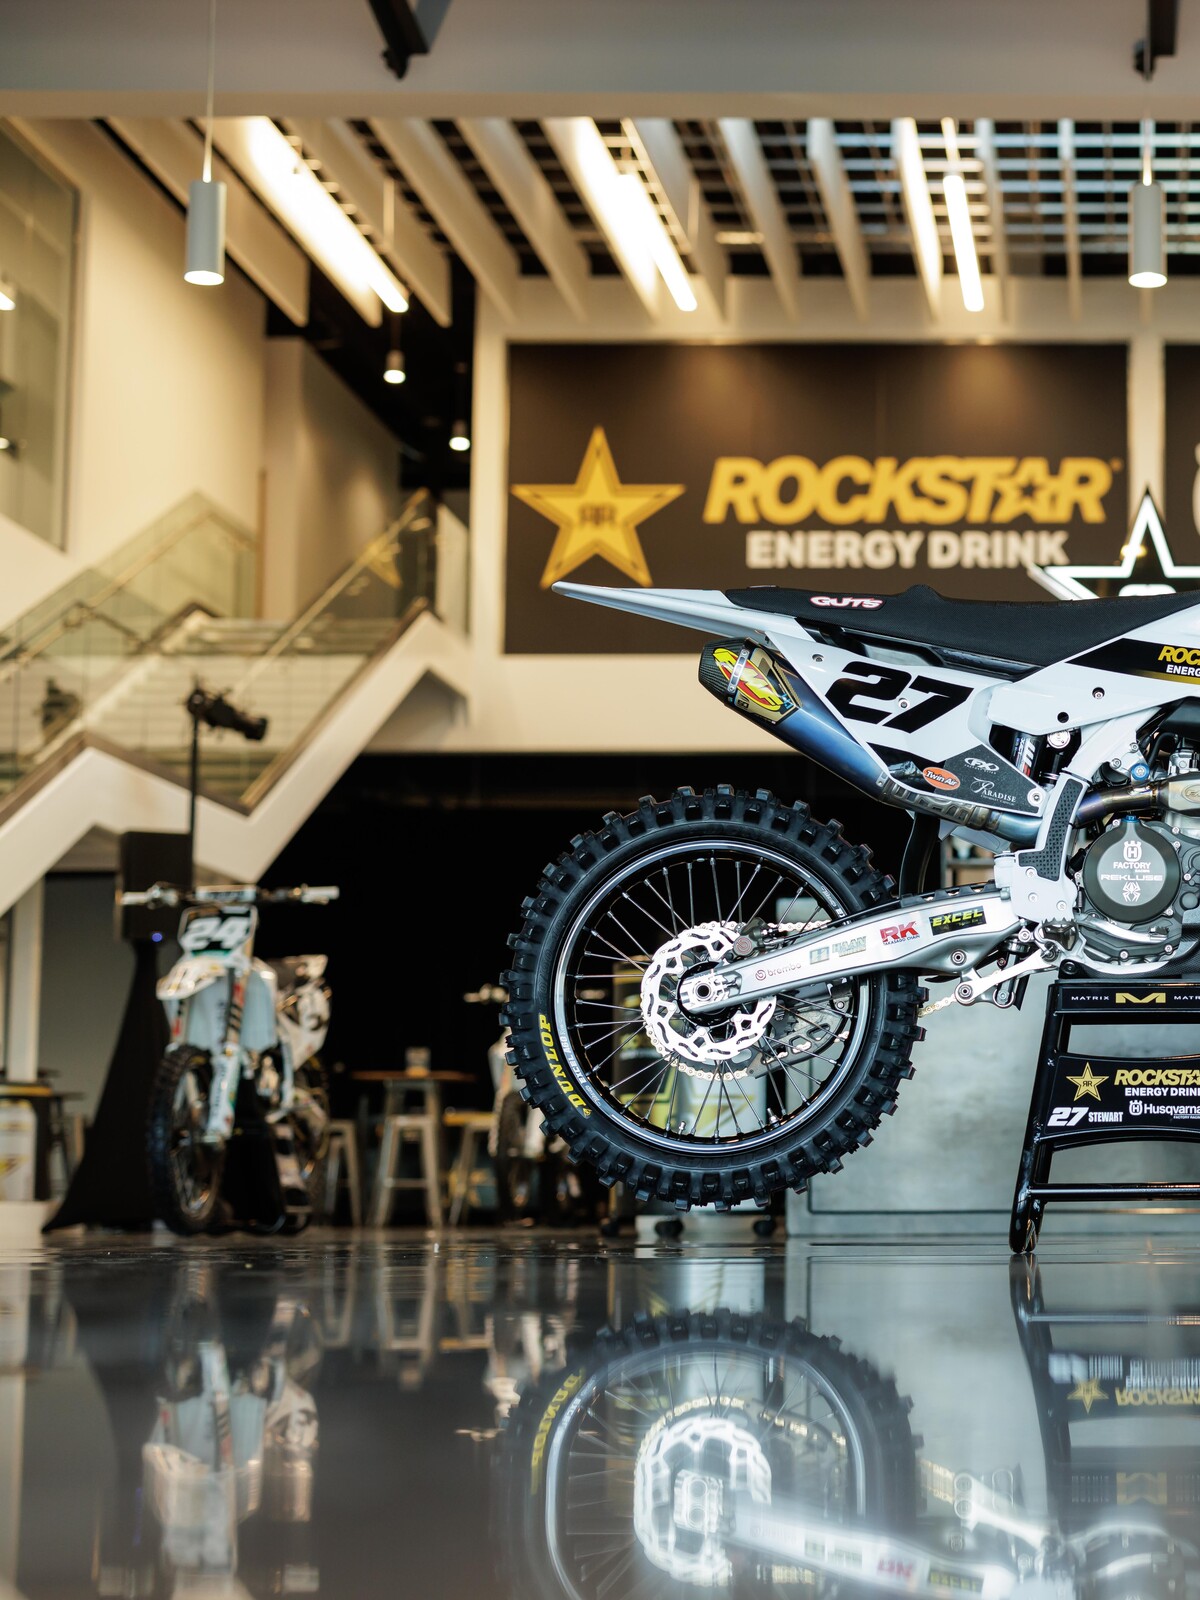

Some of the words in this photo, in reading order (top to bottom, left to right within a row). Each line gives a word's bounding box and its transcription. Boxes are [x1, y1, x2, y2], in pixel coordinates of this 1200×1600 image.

[703, 455, 1113, 525] ROCKSTAR
[746, 530, 924, 569] ENERGY
[927, 530, 1069, 569] DRINK
[810, 596, 883, 609] GUTS
[825, 661, 974, 734] 27
[925, 769, 945, 783] Twin
[943, 777, 958, 787] Air
[970, 777, 1017, 803] PARADISE
[1113, 861, 1151, 870] FACTORY
[932, 909, 983, 927] EXCEL
[181, 916, 250, 950] 24
[880, 921, 919, 942] RK
[767, 963, 802, 977] brembo
[539, 1014, 587, 1108] DUNLOP
[1125, 1087, 1169, 1097] ENERGY
[1047, 1107, 1089, 1126] 27
[1088, 1111, 1123, 1123] STEWART
